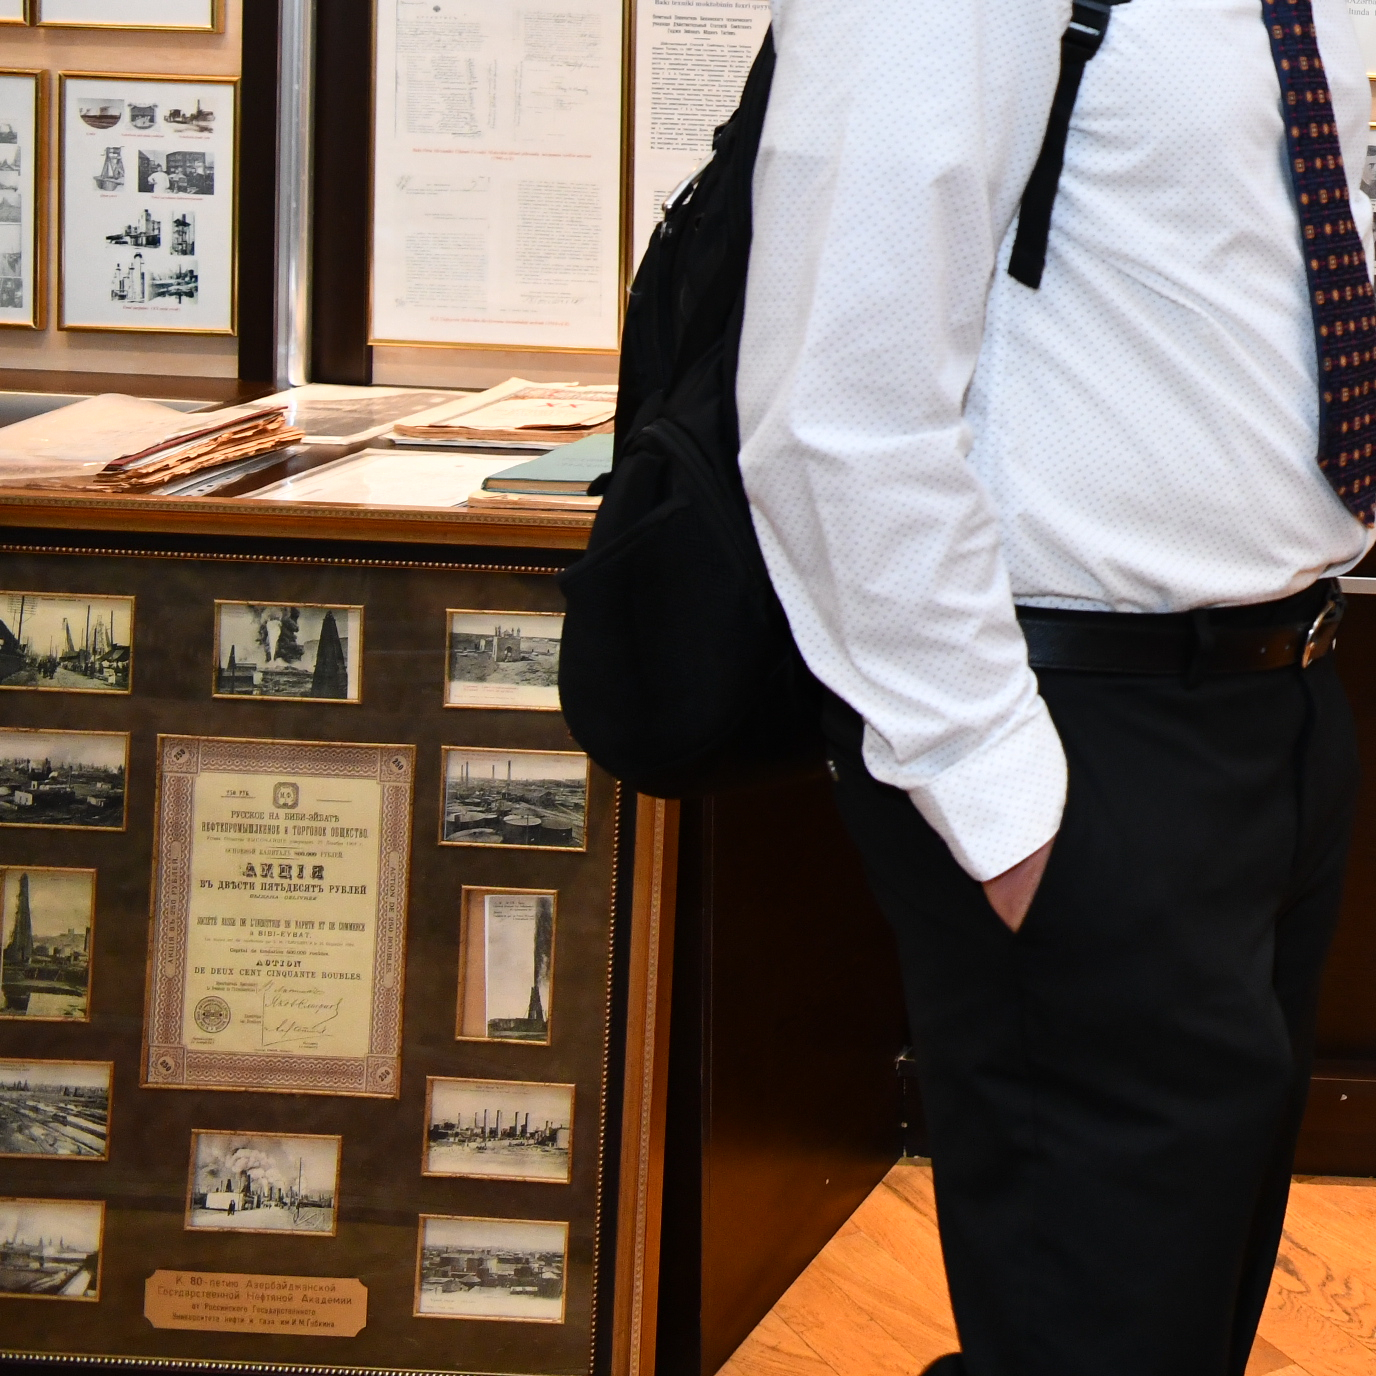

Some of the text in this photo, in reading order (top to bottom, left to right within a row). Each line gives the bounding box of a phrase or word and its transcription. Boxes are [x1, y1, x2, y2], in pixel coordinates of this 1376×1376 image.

[174, 748, 186, 761] 250
[392, 758, 404, 771] 250
[329, 885, 367, 895] РУБЛЕЙ
[194, 966, 206, 974] DE
[210, 967, 234, 976] DEUX
[239, 968, 262, 977] CENT
[266, 969, 316, 979] CINQUANTE
[159, 1056, 172, 1072] 250
[379, 1070, 391, 1082] 250
